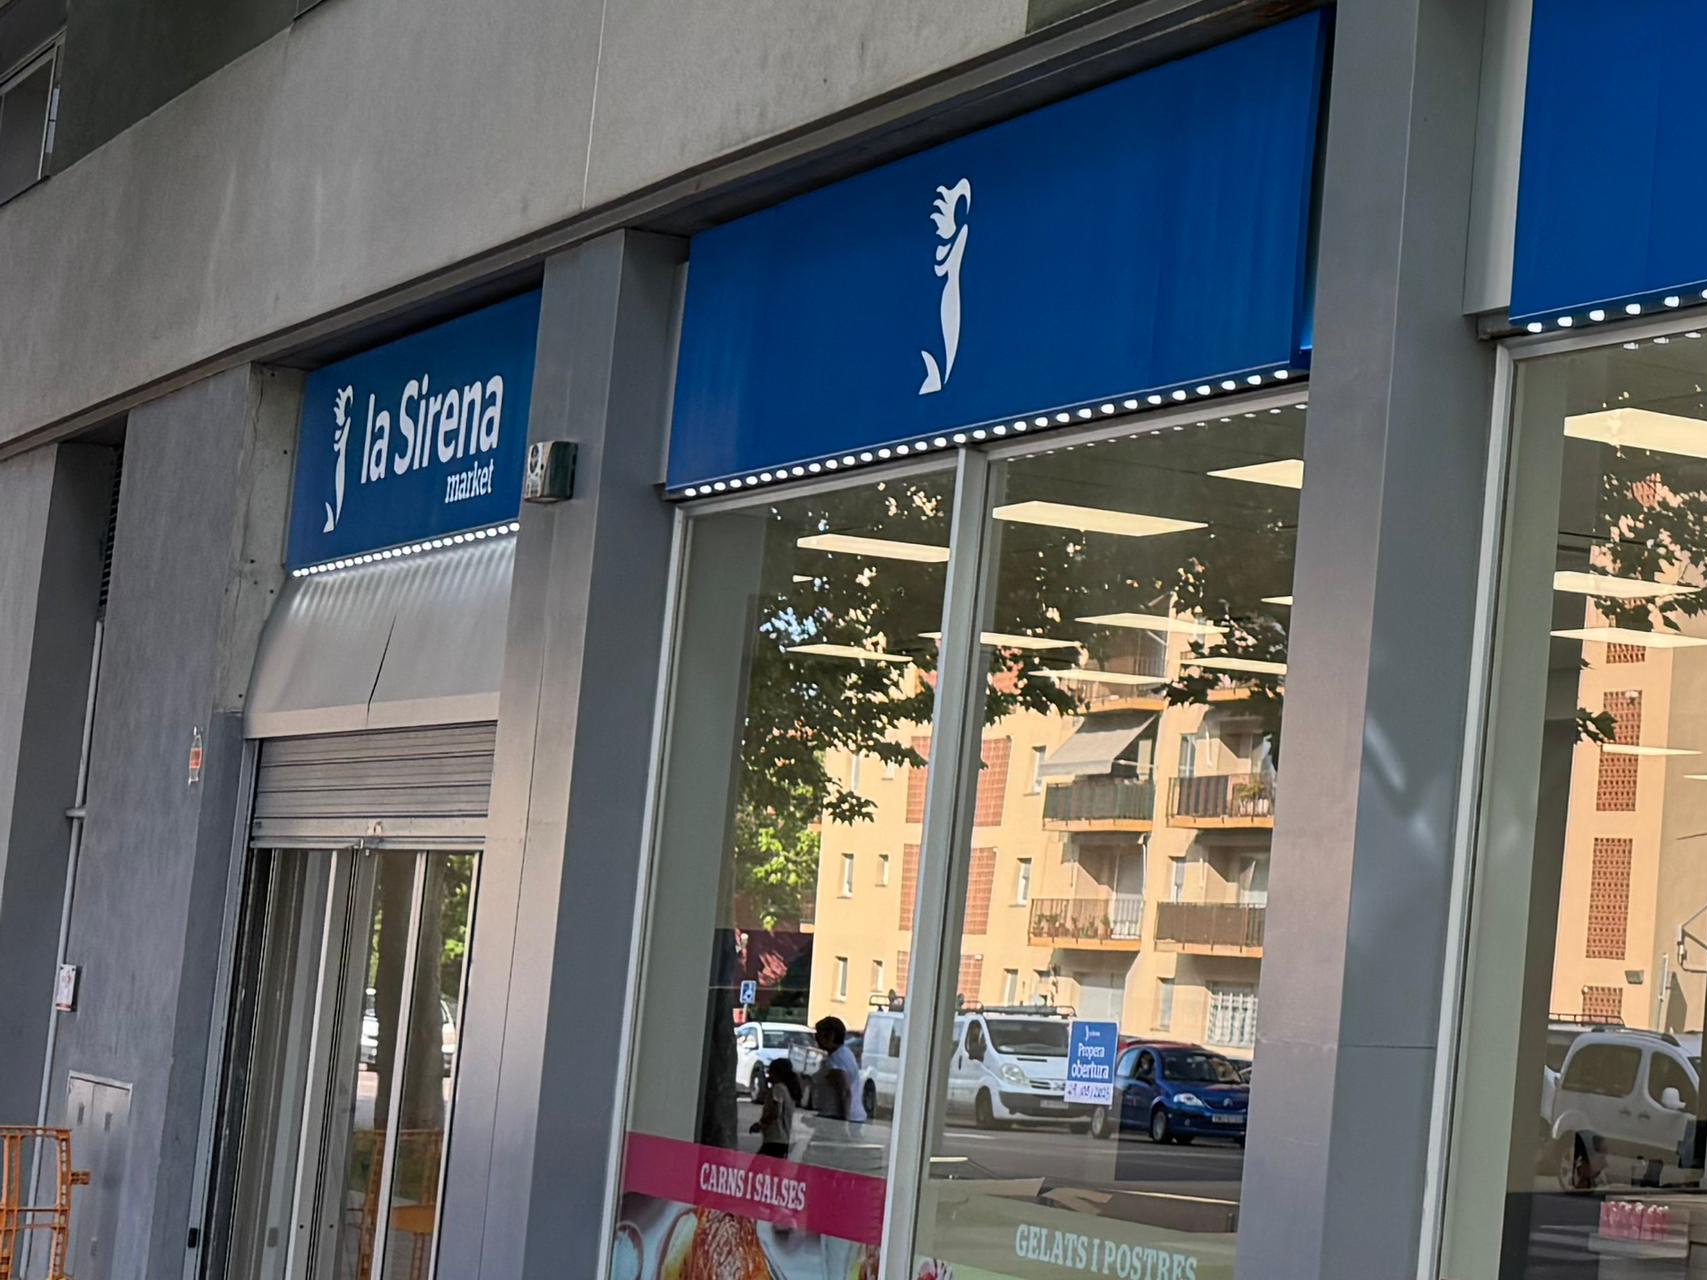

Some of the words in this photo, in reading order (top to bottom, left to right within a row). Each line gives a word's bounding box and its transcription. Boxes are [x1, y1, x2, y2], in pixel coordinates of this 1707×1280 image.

[360, 393, 391, 485] la
[394, 372, 504, 477] Sirena
[444, 460, 494, 504] market
[1071, 1060, 1109, 1079] obertura
[699, 1162, 746, 1198] CARNS
[745, 1171, 754, 1200] I
[753, 1172, 807, 1211] SALSES
[1015, 1223, 1089, 1270] GELATS
[1091, 1238, 1101, 1273] I
